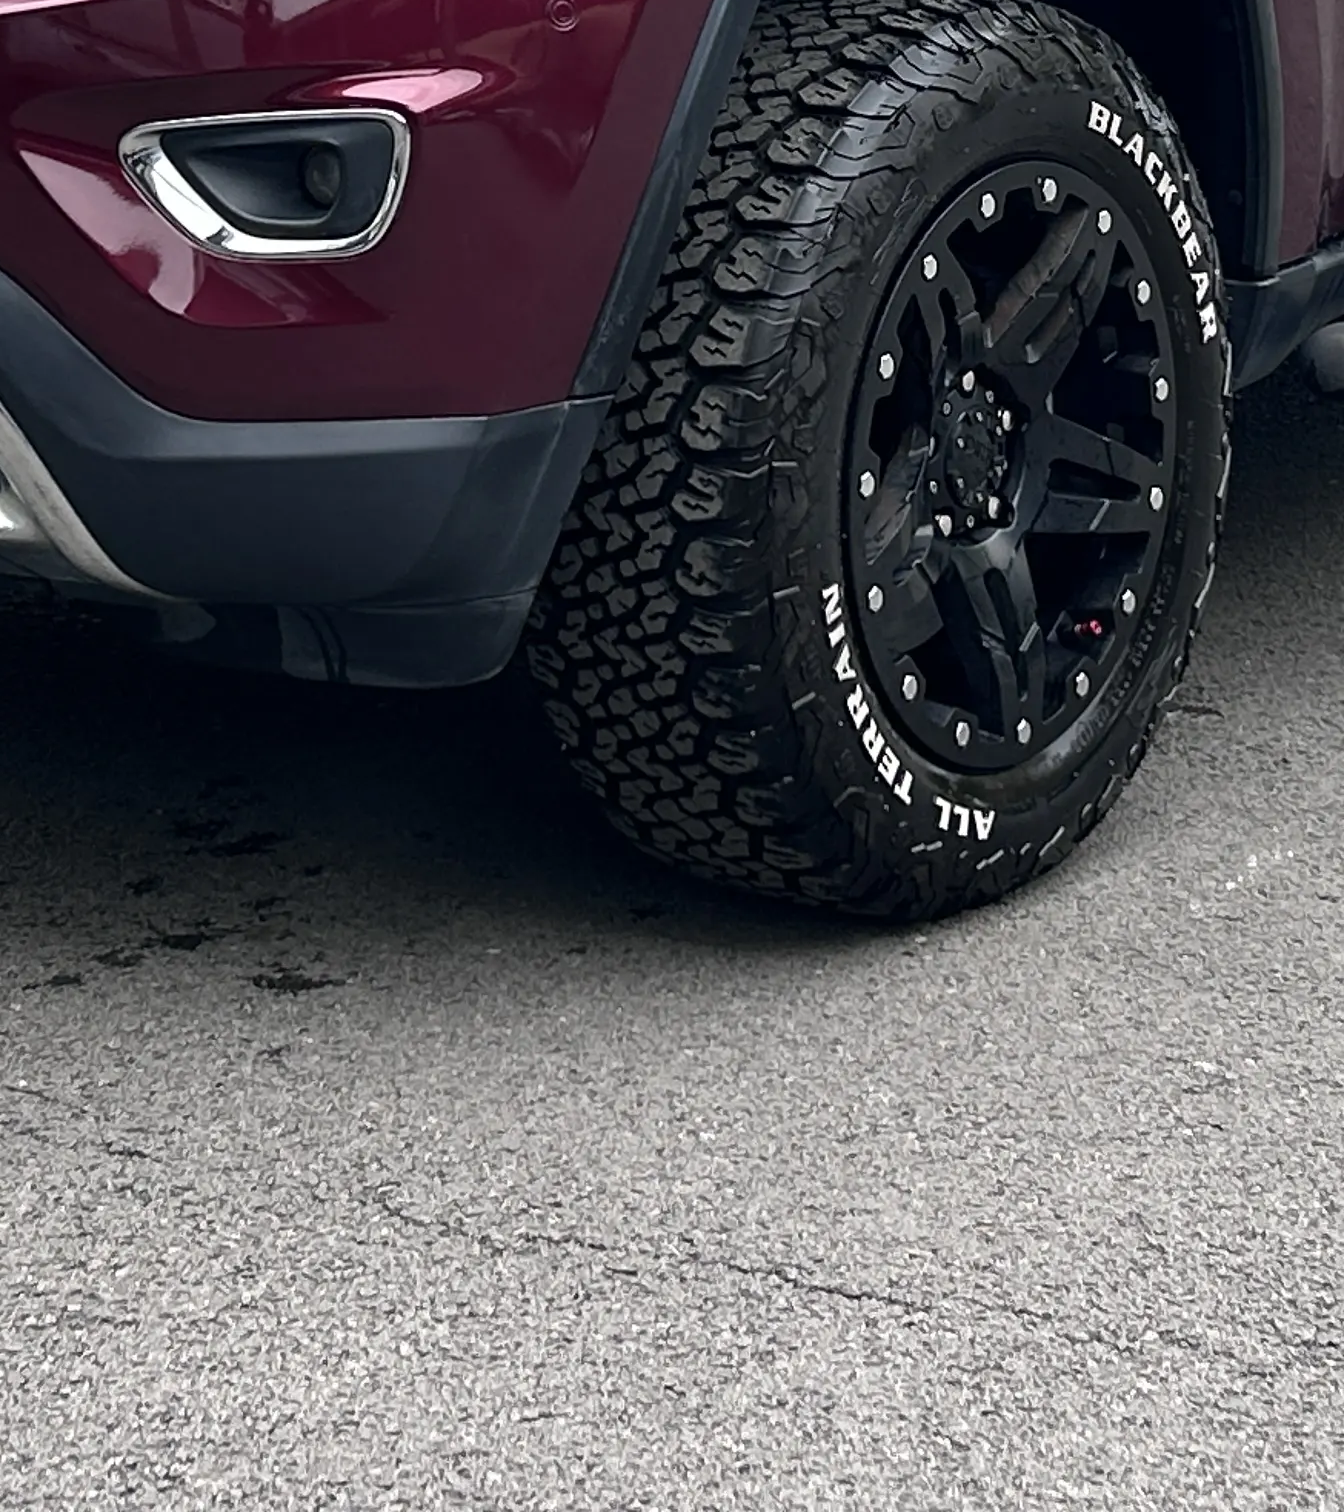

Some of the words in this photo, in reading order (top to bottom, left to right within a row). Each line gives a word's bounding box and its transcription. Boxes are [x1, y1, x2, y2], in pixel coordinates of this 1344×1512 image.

[1087, 100, 1218, 344] BLACKBEAR
[821, 583, 913, 806] TERRAIN
[933, 795, 996, 841] ALL
